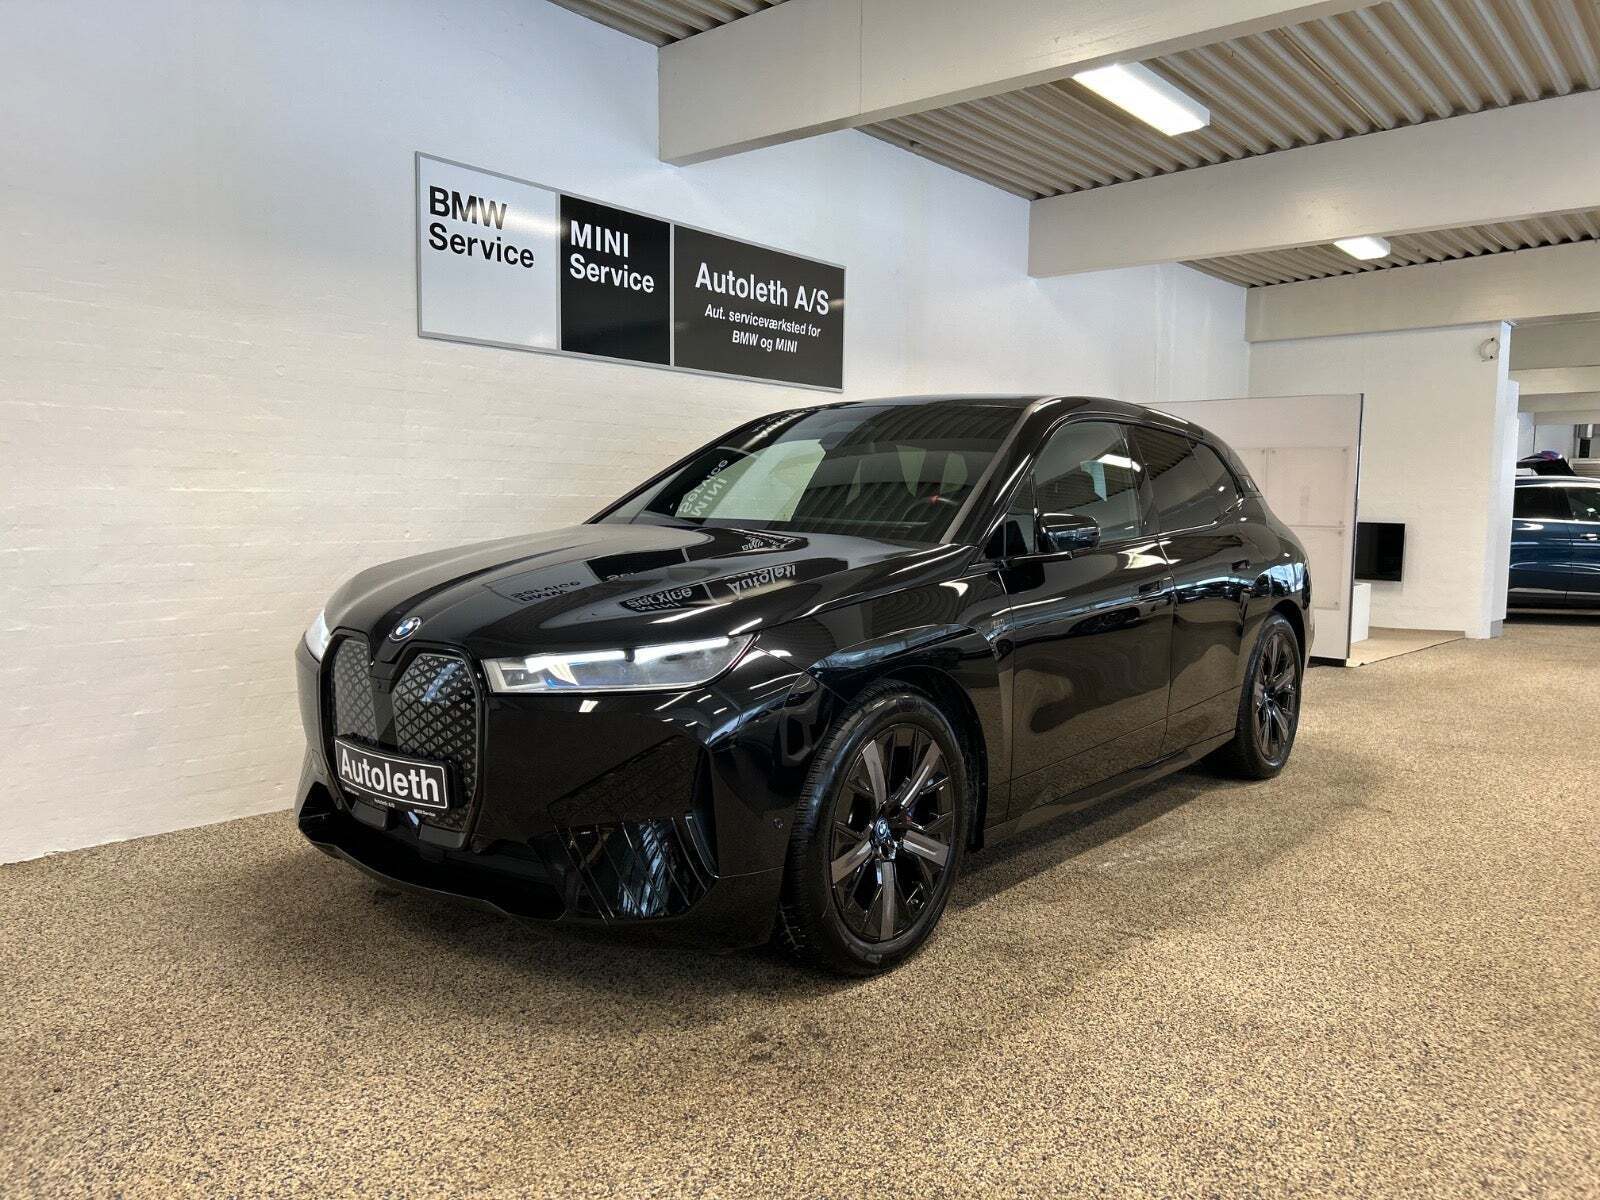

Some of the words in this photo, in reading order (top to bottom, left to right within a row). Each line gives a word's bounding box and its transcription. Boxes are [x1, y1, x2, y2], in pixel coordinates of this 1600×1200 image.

[429, 186, 507, 231] BMW
[429, 222, 535, 269] Service
[570, 219, 629, 258] MINI
[569, 253, 655, 294] Service
[695, 262, 789, 307] Autoleth
[794, 285, 830, 316] A/S
[704, 303, 725, 321] Aut.
[728, 311, 805, 337] serviceværksted
[808, 323, 821, 338] for
[731, 329, 759, 347] BMW
[760, 337, 774, 353] og
[775, 337, 798, 353] MINI
[341, 747, 440, 803] Autoleth
